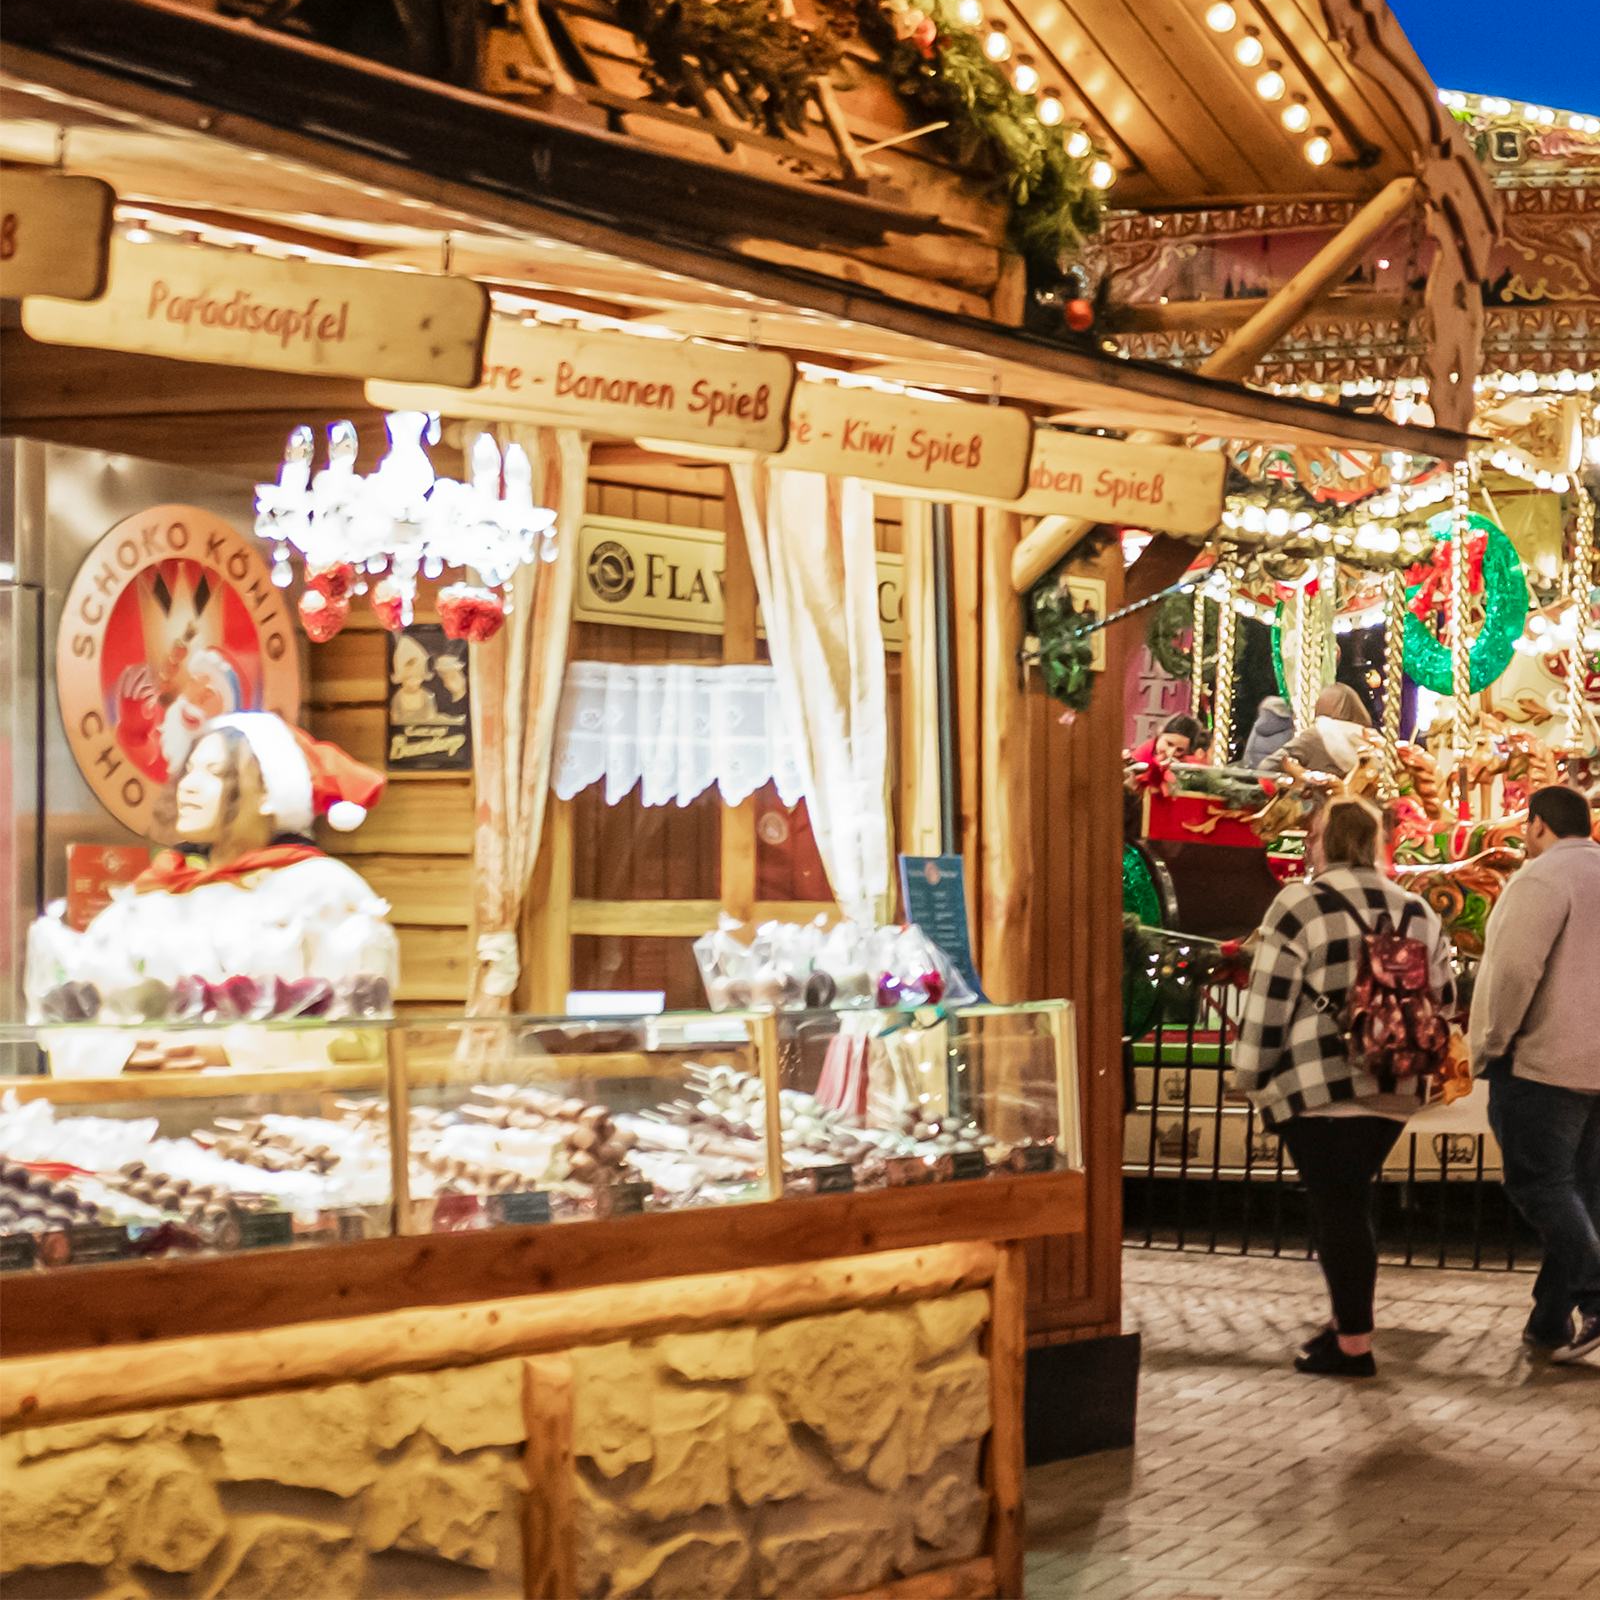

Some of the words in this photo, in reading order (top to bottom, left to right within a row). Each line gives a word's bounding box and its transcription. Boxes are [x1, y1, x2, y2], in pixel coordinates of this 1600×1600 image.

[555, 361, 675, 410] Bananen
[686, 377, 771, 426] Spieß
[841, 418, 896, 455] Kiwi
[907, 428, 983, 472] Spieß
[1094, 468, 1165, 508] Spieß
[72, 521, 190, 660] SCHOKO
[644, 553, 725, 603] FLA
